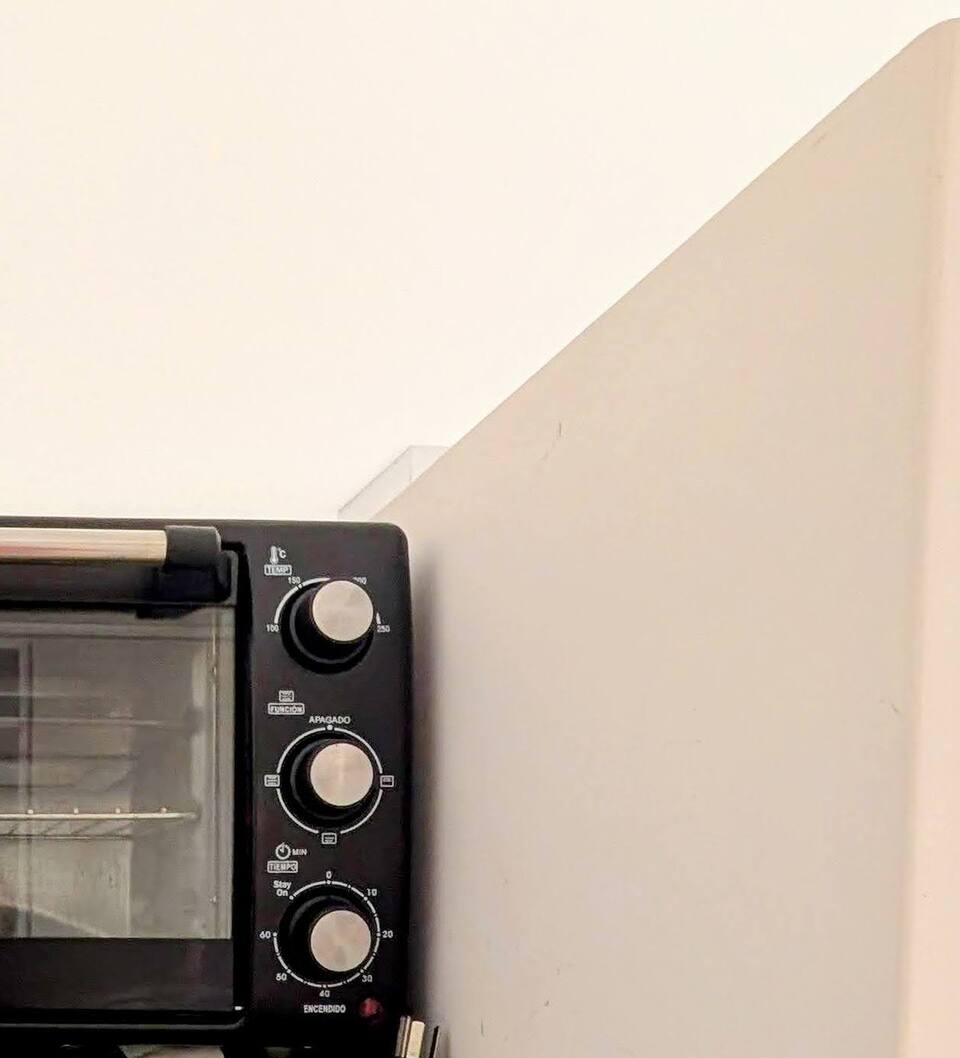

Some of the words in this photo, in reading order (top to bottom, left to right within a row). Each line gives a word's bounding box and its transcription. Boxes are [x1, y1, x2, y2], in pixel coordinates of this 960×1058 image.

[267, 566, 289, 575] TEMP
[266, 624, 279, 632] 100
[377, 625, 390, 633] 250
[309, 716, 351, 724] APAGADO
[292, 848, 308, 856] MIN
[269, 862, 297, 871] TIEMPO
[326, 871, 332, 879] 0
[273, 880, 292, 889] Stay
[367, 888, 378, 896] 10
[259, 930, 271, 939] 60
[382, 930, 394, 938] 20
[362, 974, 373, 982] 30
[303, 1004, 346, 1014] ENCENDIDO
